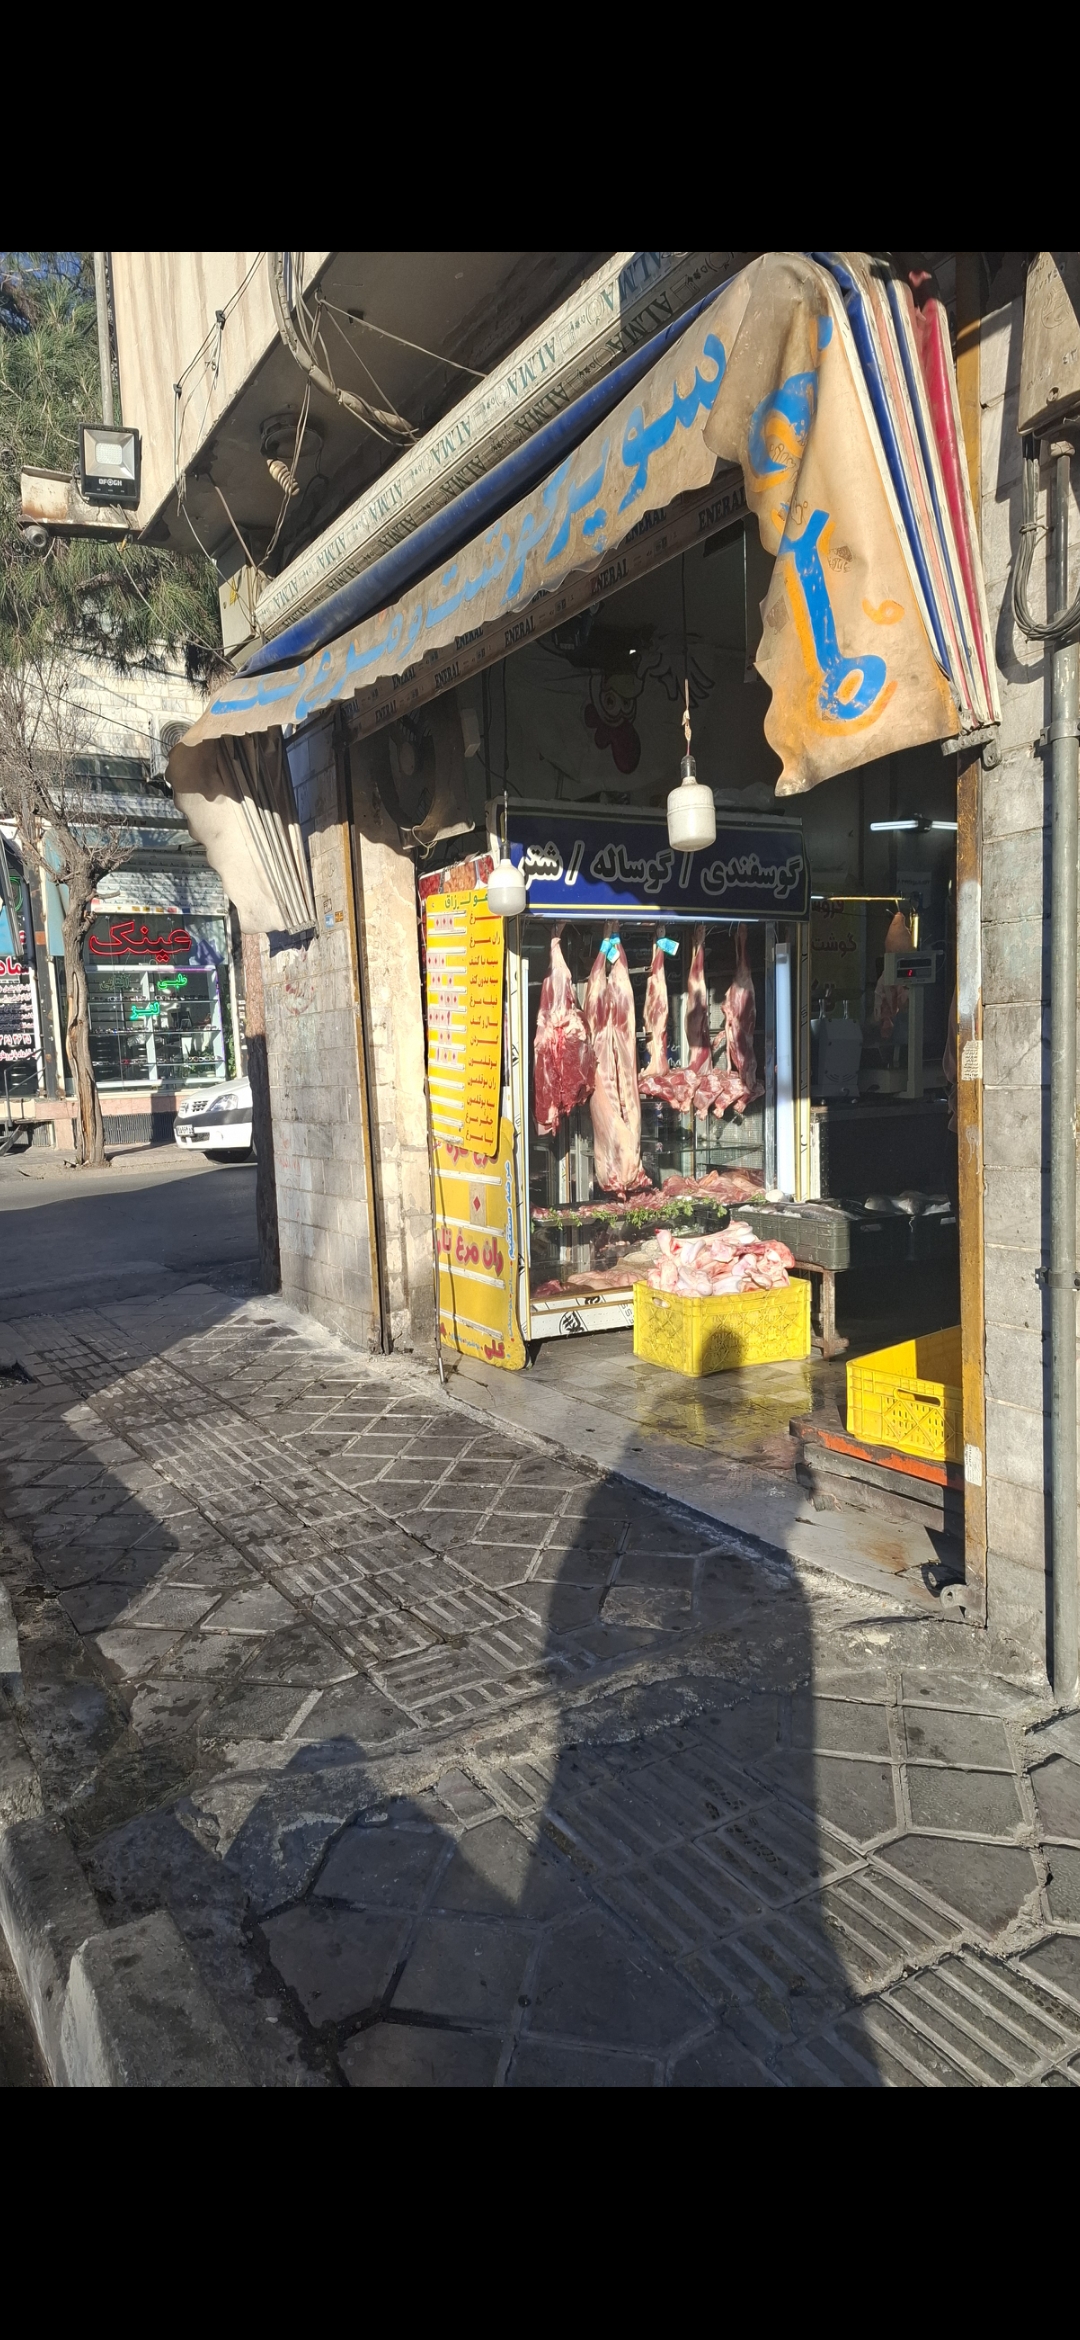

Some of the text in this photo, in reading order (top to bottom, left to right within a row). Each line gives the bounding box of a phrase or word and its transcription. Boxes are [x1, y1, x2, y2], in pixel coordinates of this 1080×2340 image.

[368, 483, 404, 523] ALMA
[430, 415, 472, 465] ALMA
[506, 336, 556, 395] ALMA
[601, 252, 661, 311] ALMA
[378, 513, 419, 550] ALMA
[439, 454, 488, 496] ALMA
[513, 382, 571, 434] ALMA
[605, 290, 674, 354] ALMA
[504, 615, 535, 648] ENERAL
[522, 841, 563, 891] شتر
[590, 843, 675, 894] گوساله
[702, 852, 804, 899] گوسفندی
[89, 921, 192, 962] عینک
[470, 934, 492, 948] مرغ
[811, 932, 858, 958] گوشت
[157, 973, 187, 990] طبی
[470, 993, 482, 1007] مرغ
[130, 1002, 160, 1021] لنز
[465, 1110, 479, 1124] مرغ
[455, 1226, 479, 1266] مرغ
[503, 1207, 516, 1261] مستقیم
[482, 1235, 504, 1278] ران
